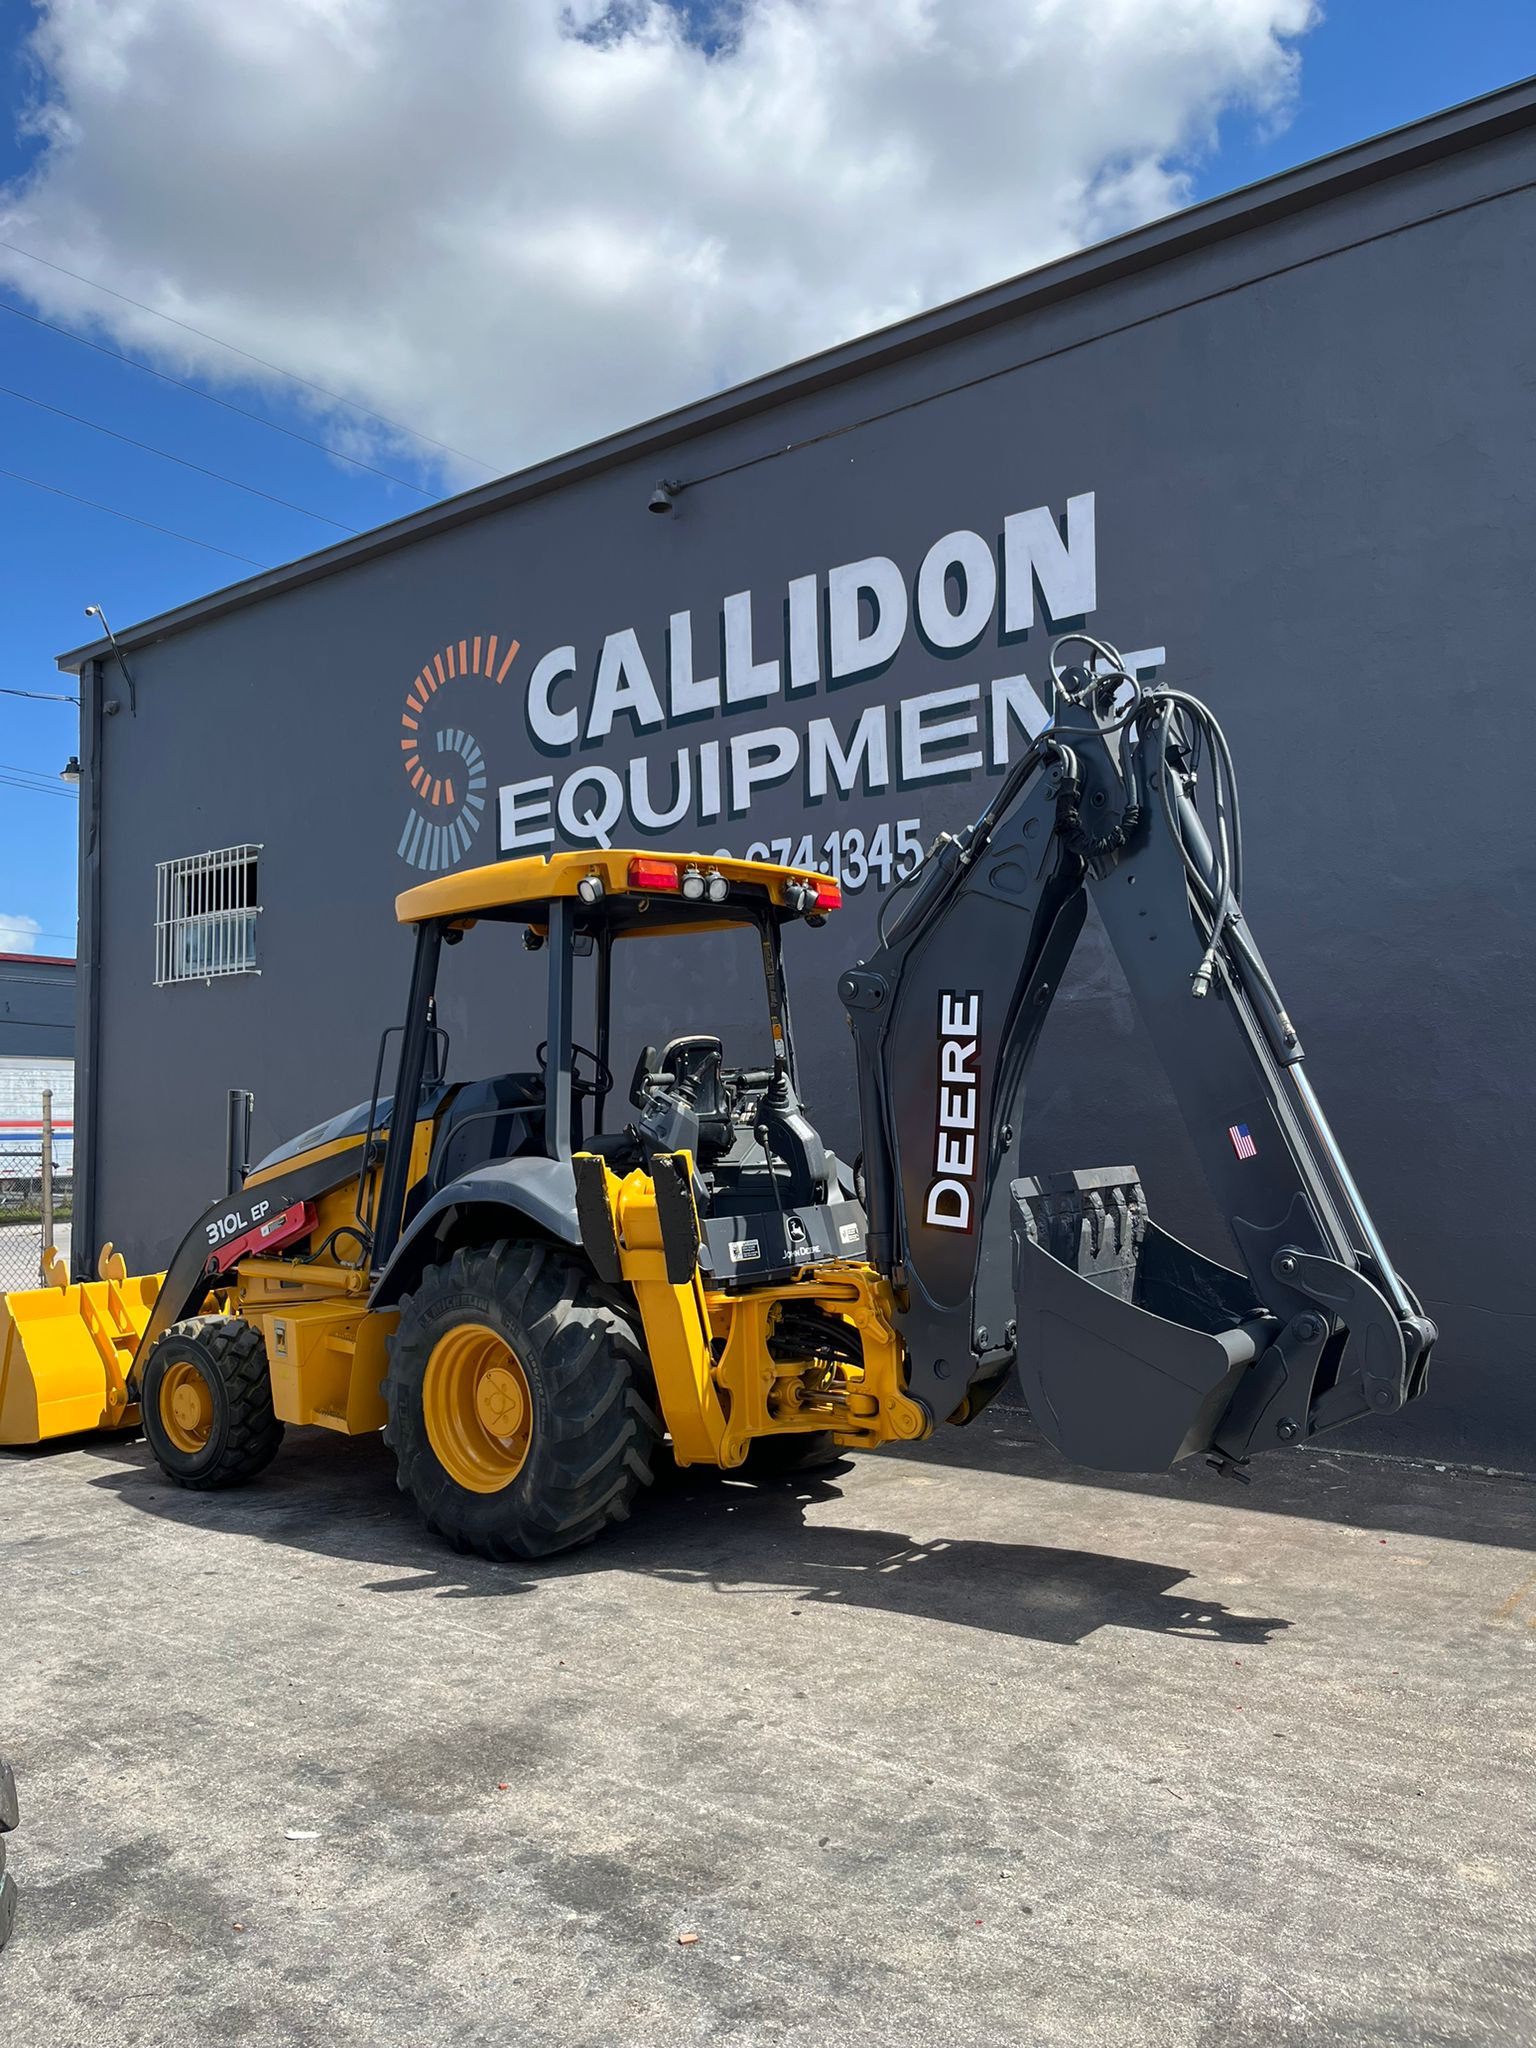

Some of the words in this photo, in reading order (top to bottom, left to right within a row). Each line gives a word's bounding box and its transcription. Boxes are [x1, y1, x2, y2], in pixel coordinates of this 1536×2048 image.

[527, 491, 1097, 746] CALLIDON
[926, 994, 979, 1228] DEERE
[205, 1212, 249, 1245] 310L
[250, 1200, 270, 1221] EP
[430, 1294, 488, 1316] MICHELIN
